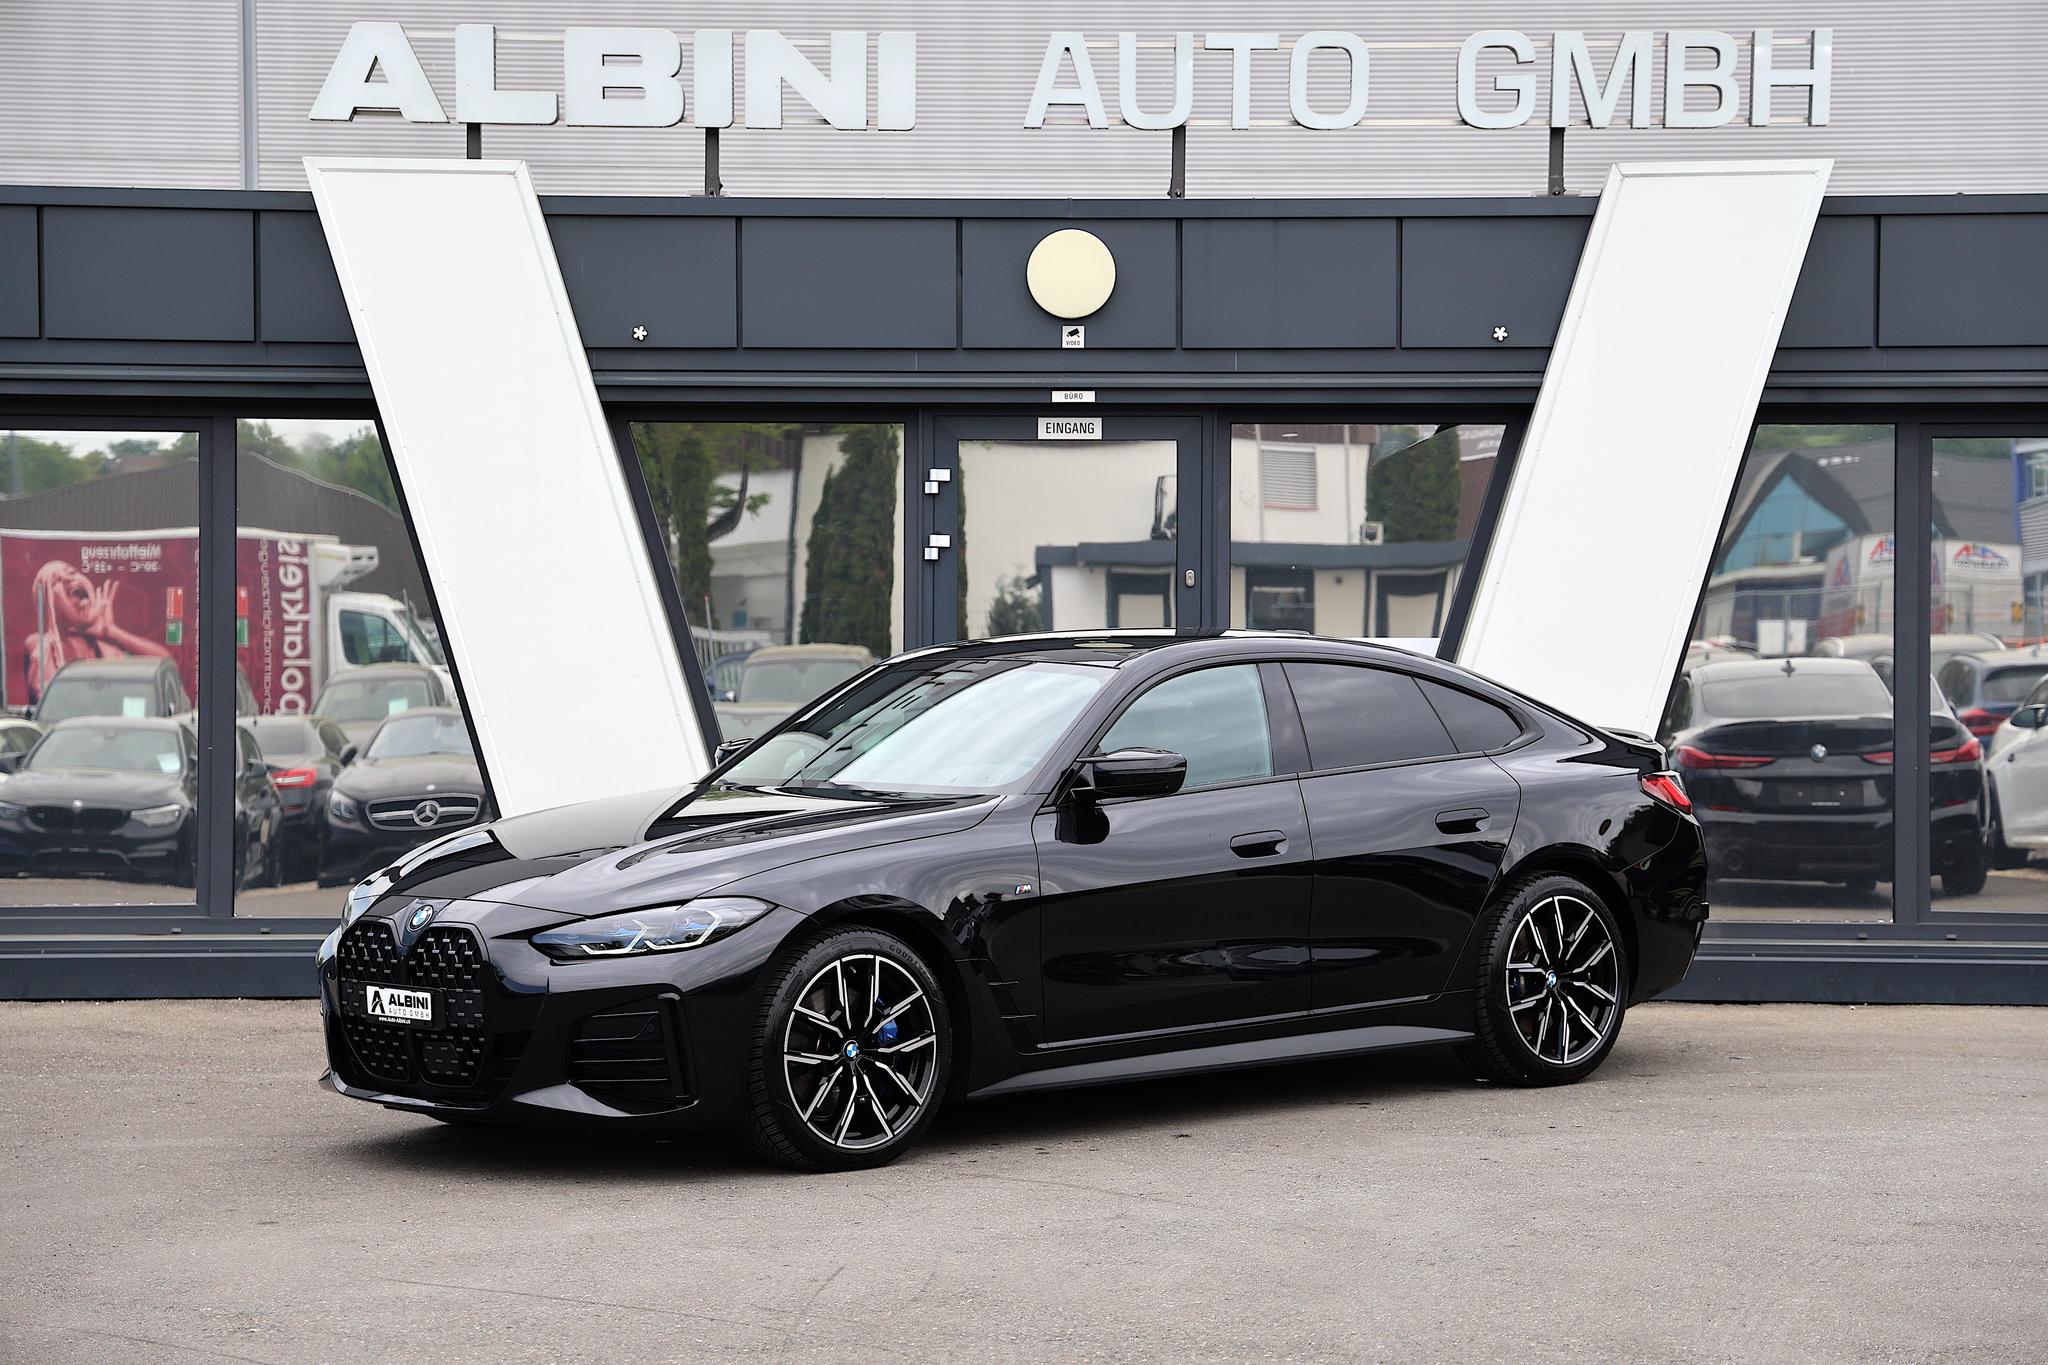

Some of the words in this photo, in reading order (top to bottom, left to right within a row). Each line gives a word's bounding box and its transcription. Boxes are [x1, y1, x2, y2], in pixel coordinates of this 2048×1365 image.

[308, 21, 917, 130] ALBINI
[1023, 30, 1371, 130] AUTO
[1455, 28, 1834, 130] GMBH
[1064, 392, 1084, 400] BÜRO
[1045, 422, 1095, 434] EINGANG
[388, 993, 428, 1010] ALBINI
[389, 1008, 406, 1016] AUTO
[409, 1010, 429, 1018] GMBH
